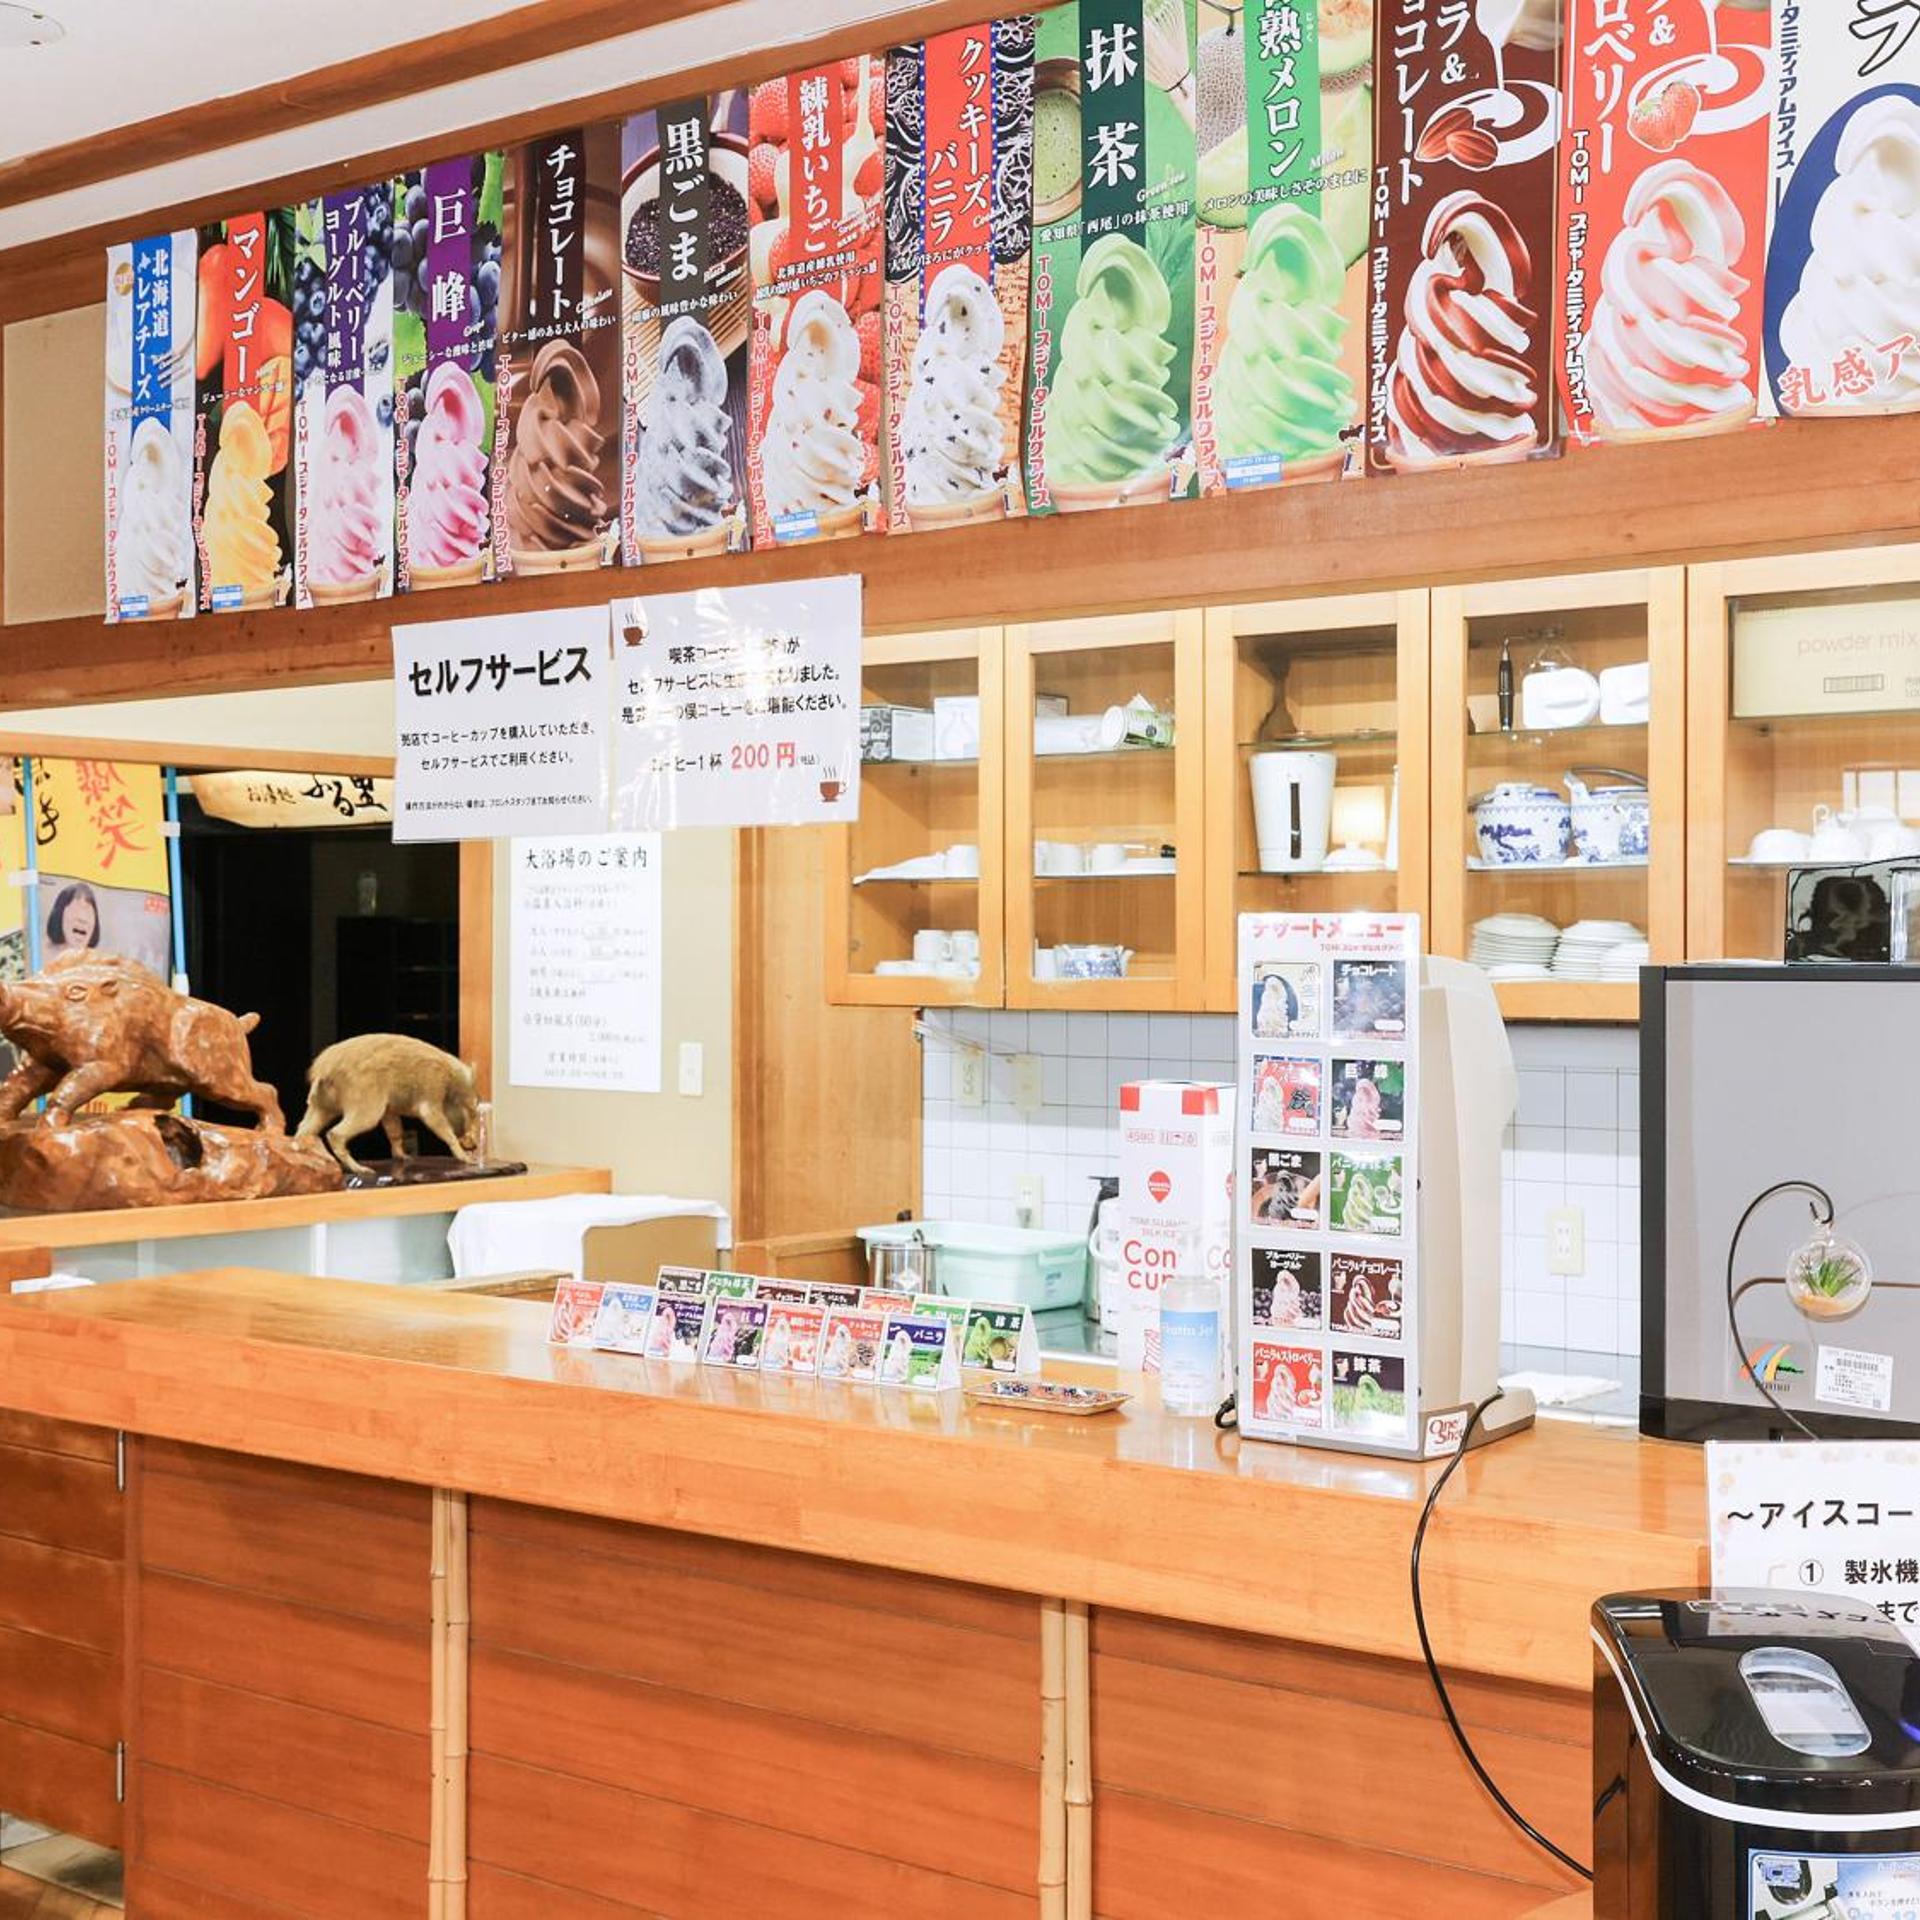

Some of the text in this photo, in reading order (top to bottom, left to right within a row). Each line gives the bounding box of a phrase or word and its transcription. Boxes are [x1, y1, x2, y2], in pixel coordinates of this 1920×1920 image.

[959, 37, 989, 215] クッキーズ
[1084, 23, 1139, 190] 抹茶
[1258, 0, 1304, 178] 熟メロン
[546, 144, 576, 319] チョコレート
[665, 117, 704, 281] 黒ごま
[800, 76, 831, 252] 練乳いちご
[929, 142, 958, 246] バニラ
[151, 249, 169, 337] 北海道
[232, 229, 260, 384] マンゴー
[325, 210, 343, 368] ヨーグルト風味
[344, 196, 366, 363] ブルーベリー
[432, 188, 467, 322] 巨峰
[135, 280, 152, 400] レアチーズ
[409, 647, 592, 697] セルフサービス
[526, 847, 648, 869] 大浴場のご案内
[1341, 964, 1397, 977] チョコレート
[913, 1330, 946, 1343] バニラ
[1845, 1559, 1919, 1585] 製氷機
